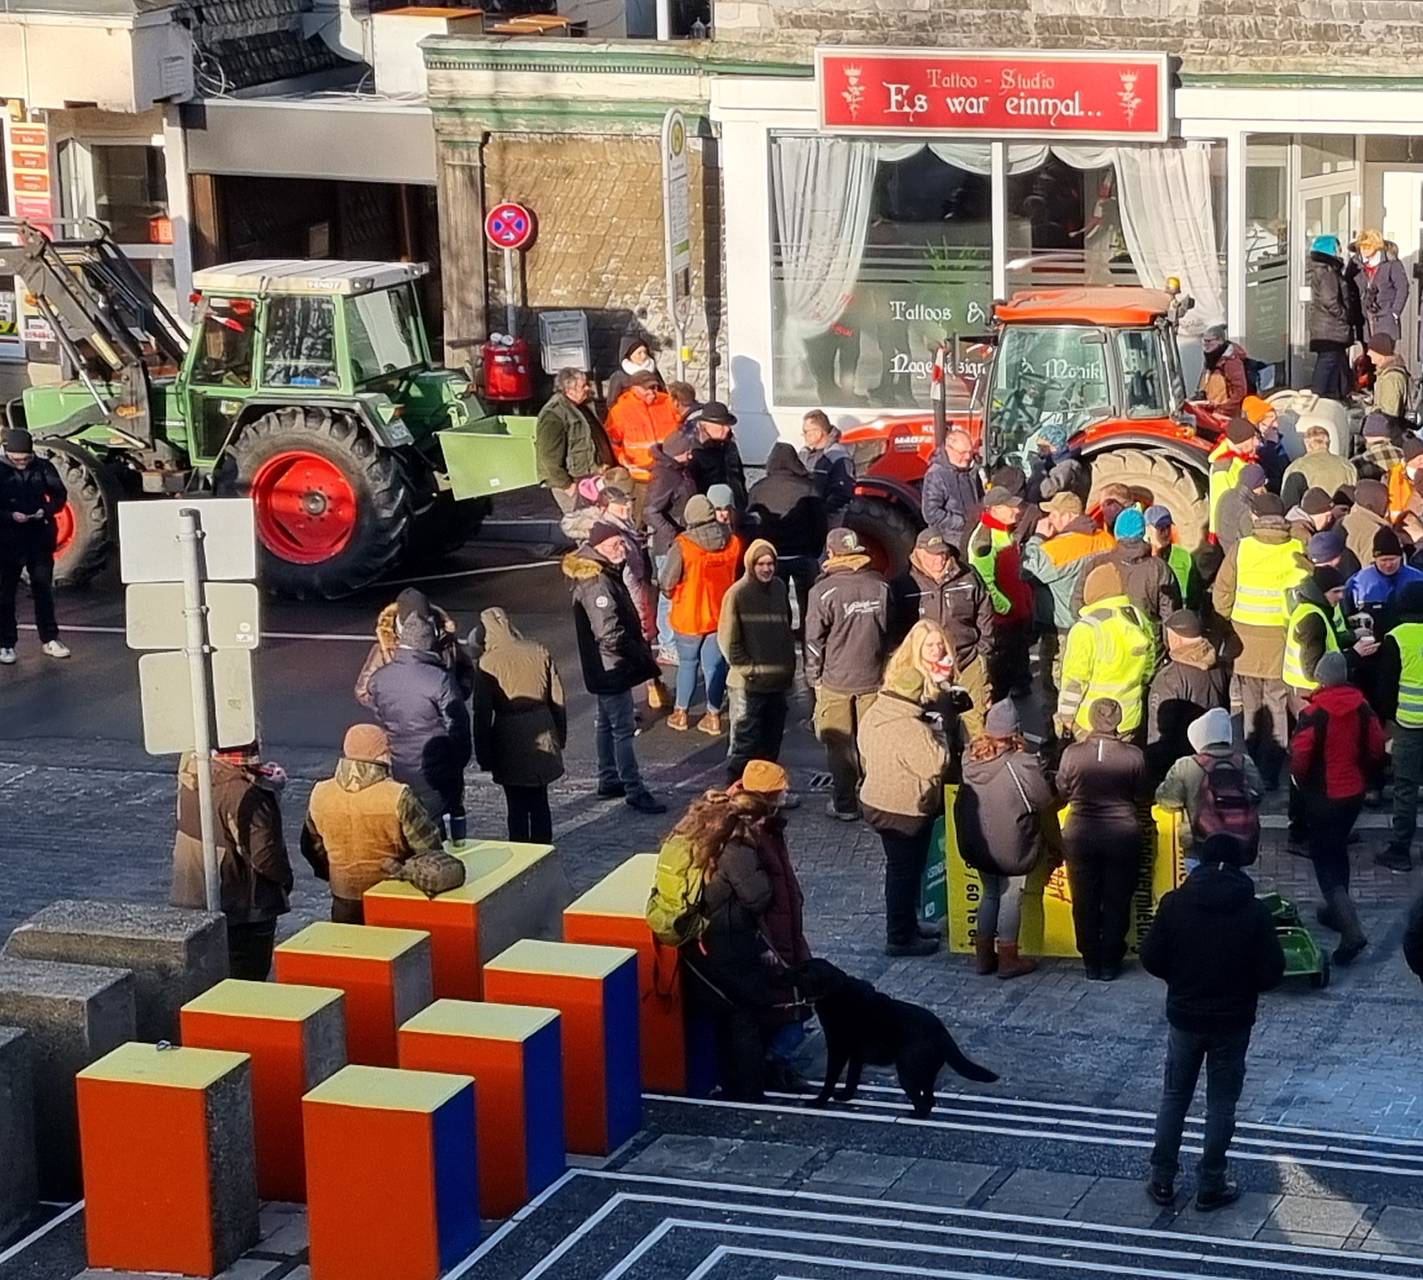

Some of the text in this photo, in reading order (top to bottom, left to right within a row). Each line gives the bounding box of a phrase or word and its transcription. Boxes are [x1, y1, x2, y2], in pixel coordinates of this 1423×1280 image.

[926, 68, 978, 89] Tattoo
[999, 68, 1055, 96] Studio
[882, 81, 928, 122] Es
[946, 95, 989, 115] war
[889, 301, 987, 323] Tattoos &
[966, 884, 980, 902] 60
